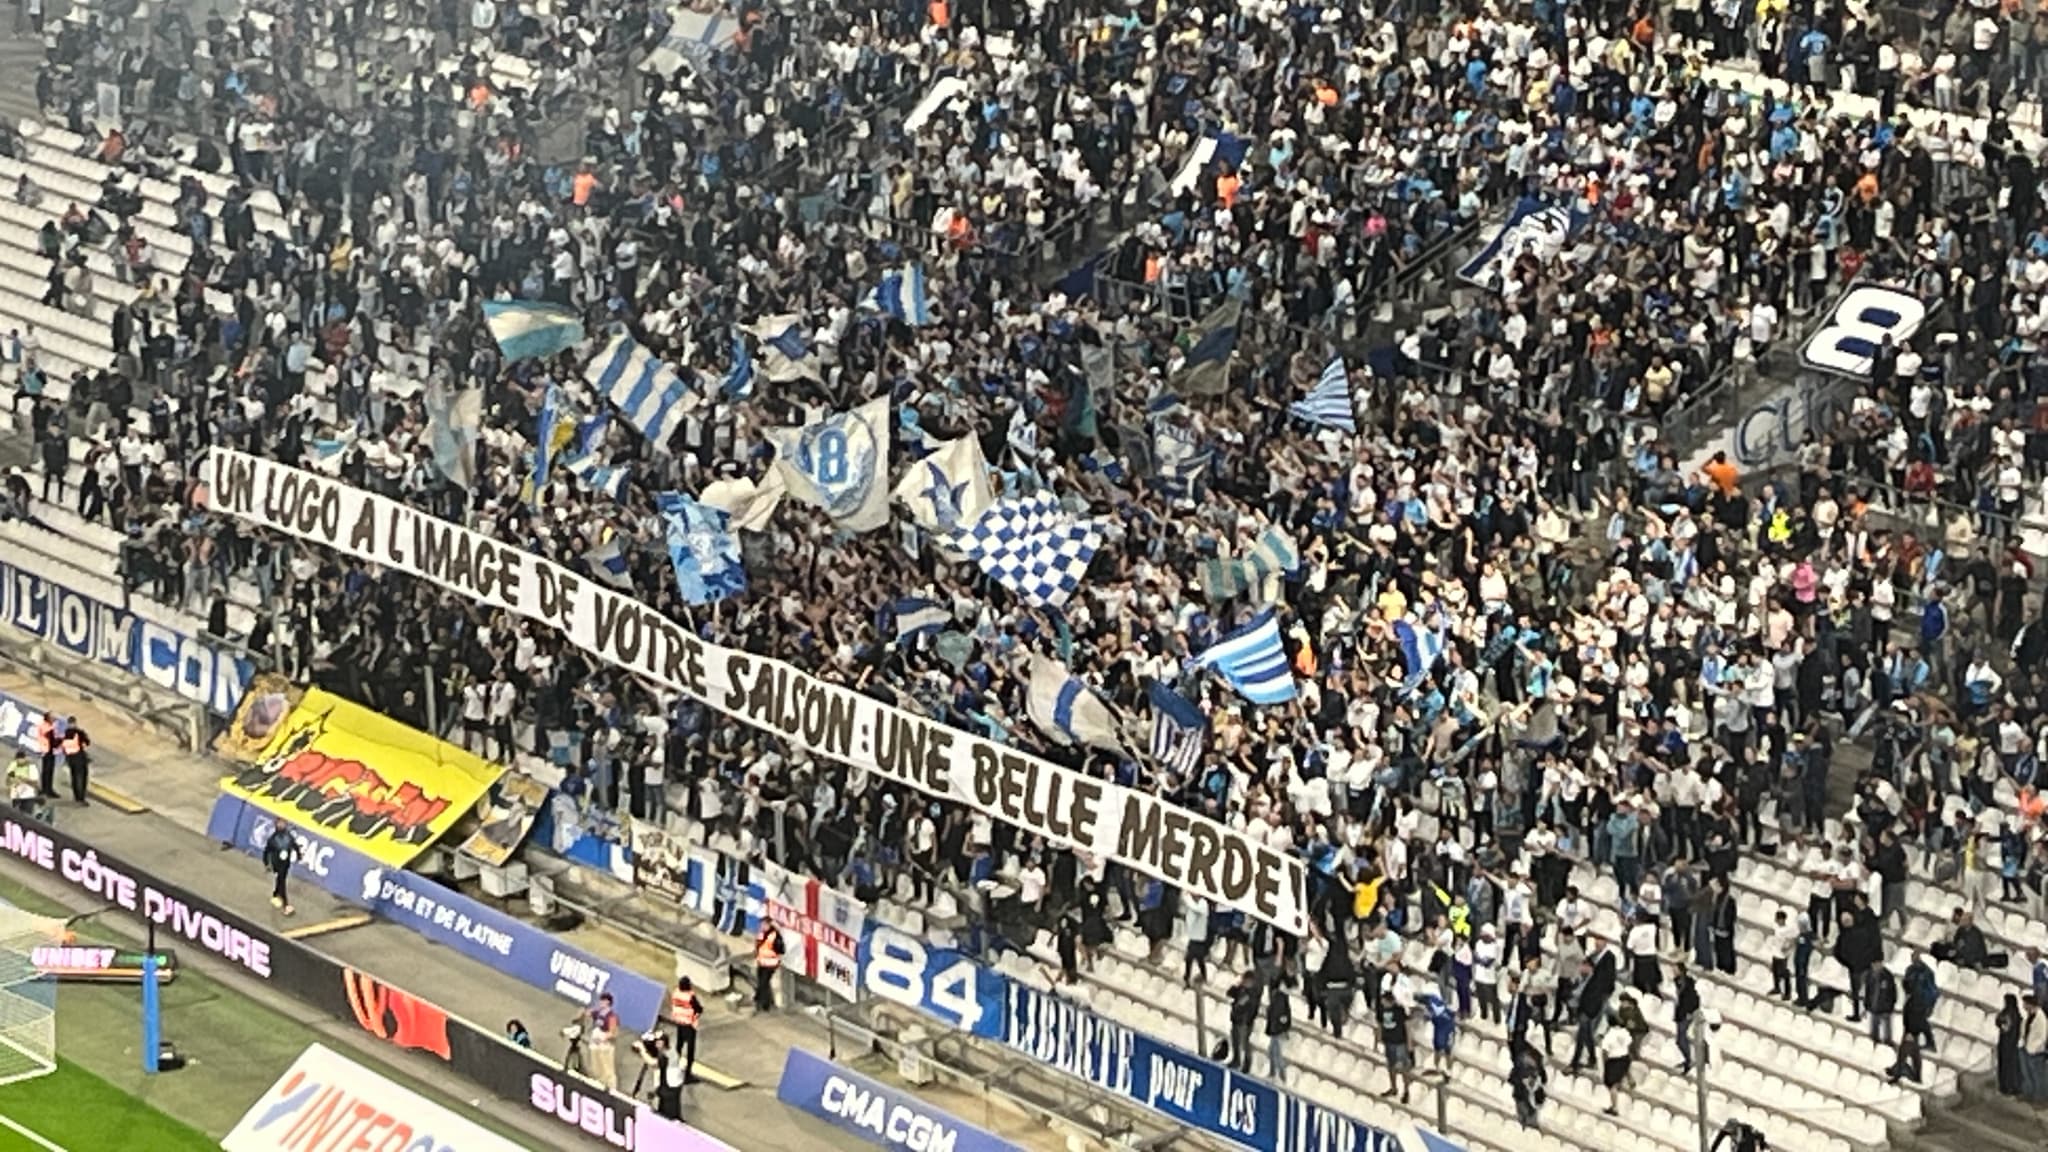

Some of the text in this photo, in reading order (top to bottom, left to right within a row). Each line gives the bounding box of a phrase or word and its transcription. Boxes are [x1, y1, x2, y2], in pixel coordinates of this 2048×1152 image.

[215, 452, 256, 512] UN
[266, 467, 341, 541] LOGO
[350, 498, 377, 554] A
[387, 509, 522, 604] L'IMAGE
[535, 561, 580, 631] DE
[593, 591, 705, 697] VOTRE
[874, 709, 954, 793] UNE
[972, 742, 1103, 846] BELLE
[31, 946, 116, 969] UNIBET
[61, 849, 137, 911] CÔTE
[144, 887, 271, 979] D'IVOIRE
[550, 950, 610, 994] UNIBET
[865, 925, 983, 1031] 84
[1008, 982, 1135, 1097] LIBERTE
[1147, 1052, 1203, 1113] pour
[1219, 1068, 1257, 1136] les
